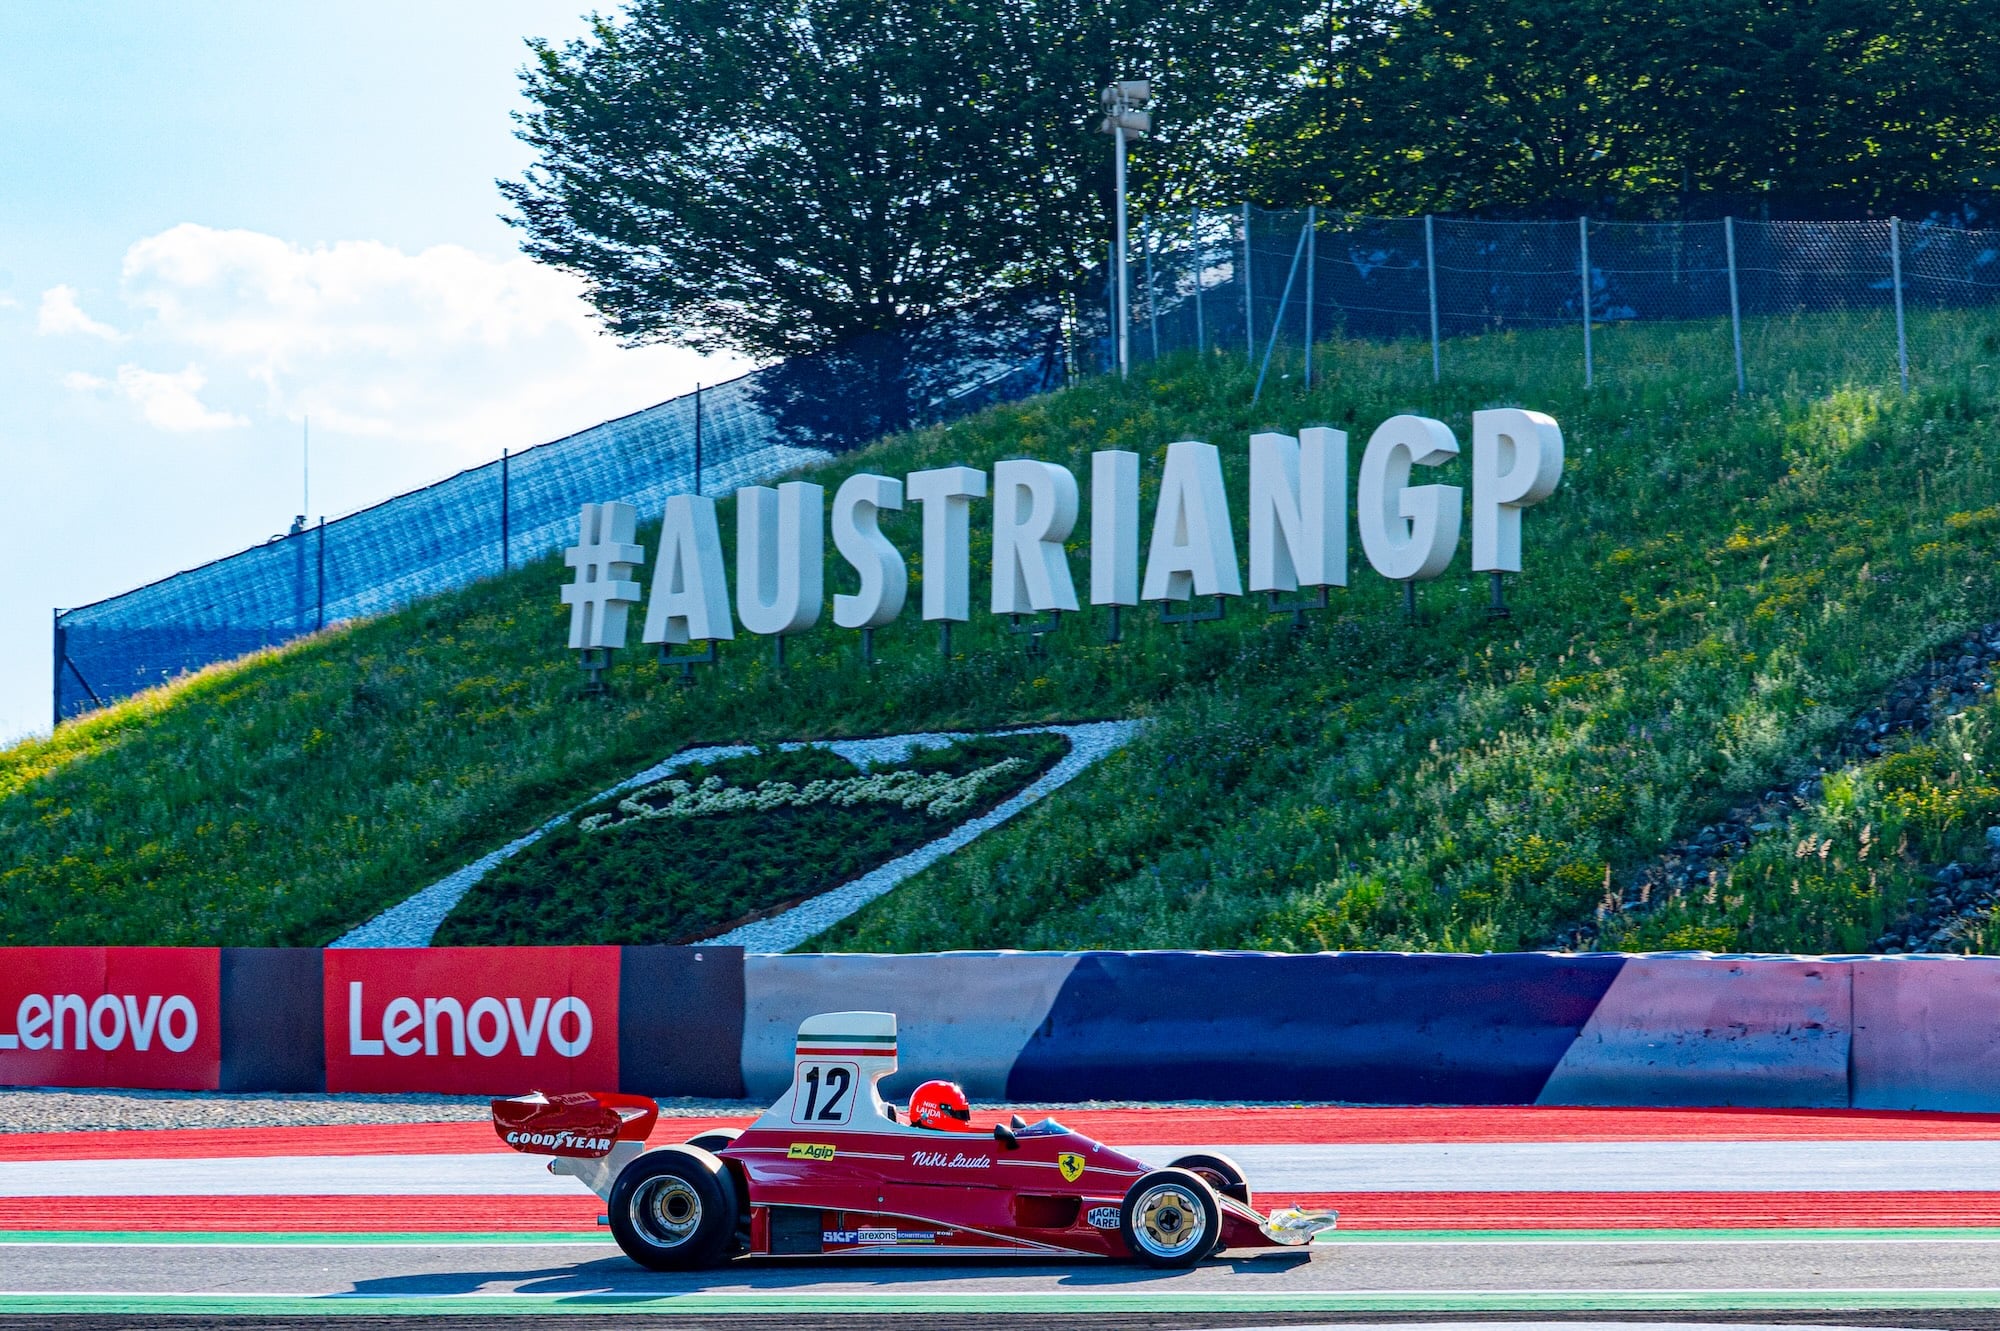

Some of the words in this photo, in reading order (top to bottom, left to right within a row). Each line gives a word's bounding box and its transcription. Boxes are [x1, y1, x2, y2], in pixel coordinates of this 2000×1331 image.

[560, 408, 1565, 649] #AUSTRIANGP
[349, 981, 593, 1058] Lenovo
[804, 1066, 850, 1121] 12
[804, 1145, 833, 1159] Agip
[947, 1152, 990, 1169] Lauda
[1089, 1208, 1121, 1219] MAGNE
[1089, 1217, 1121, 1228] MAREL
[823, 1231, 857, 1242] SKF
[859, 1231, 896, 1240] arexons
